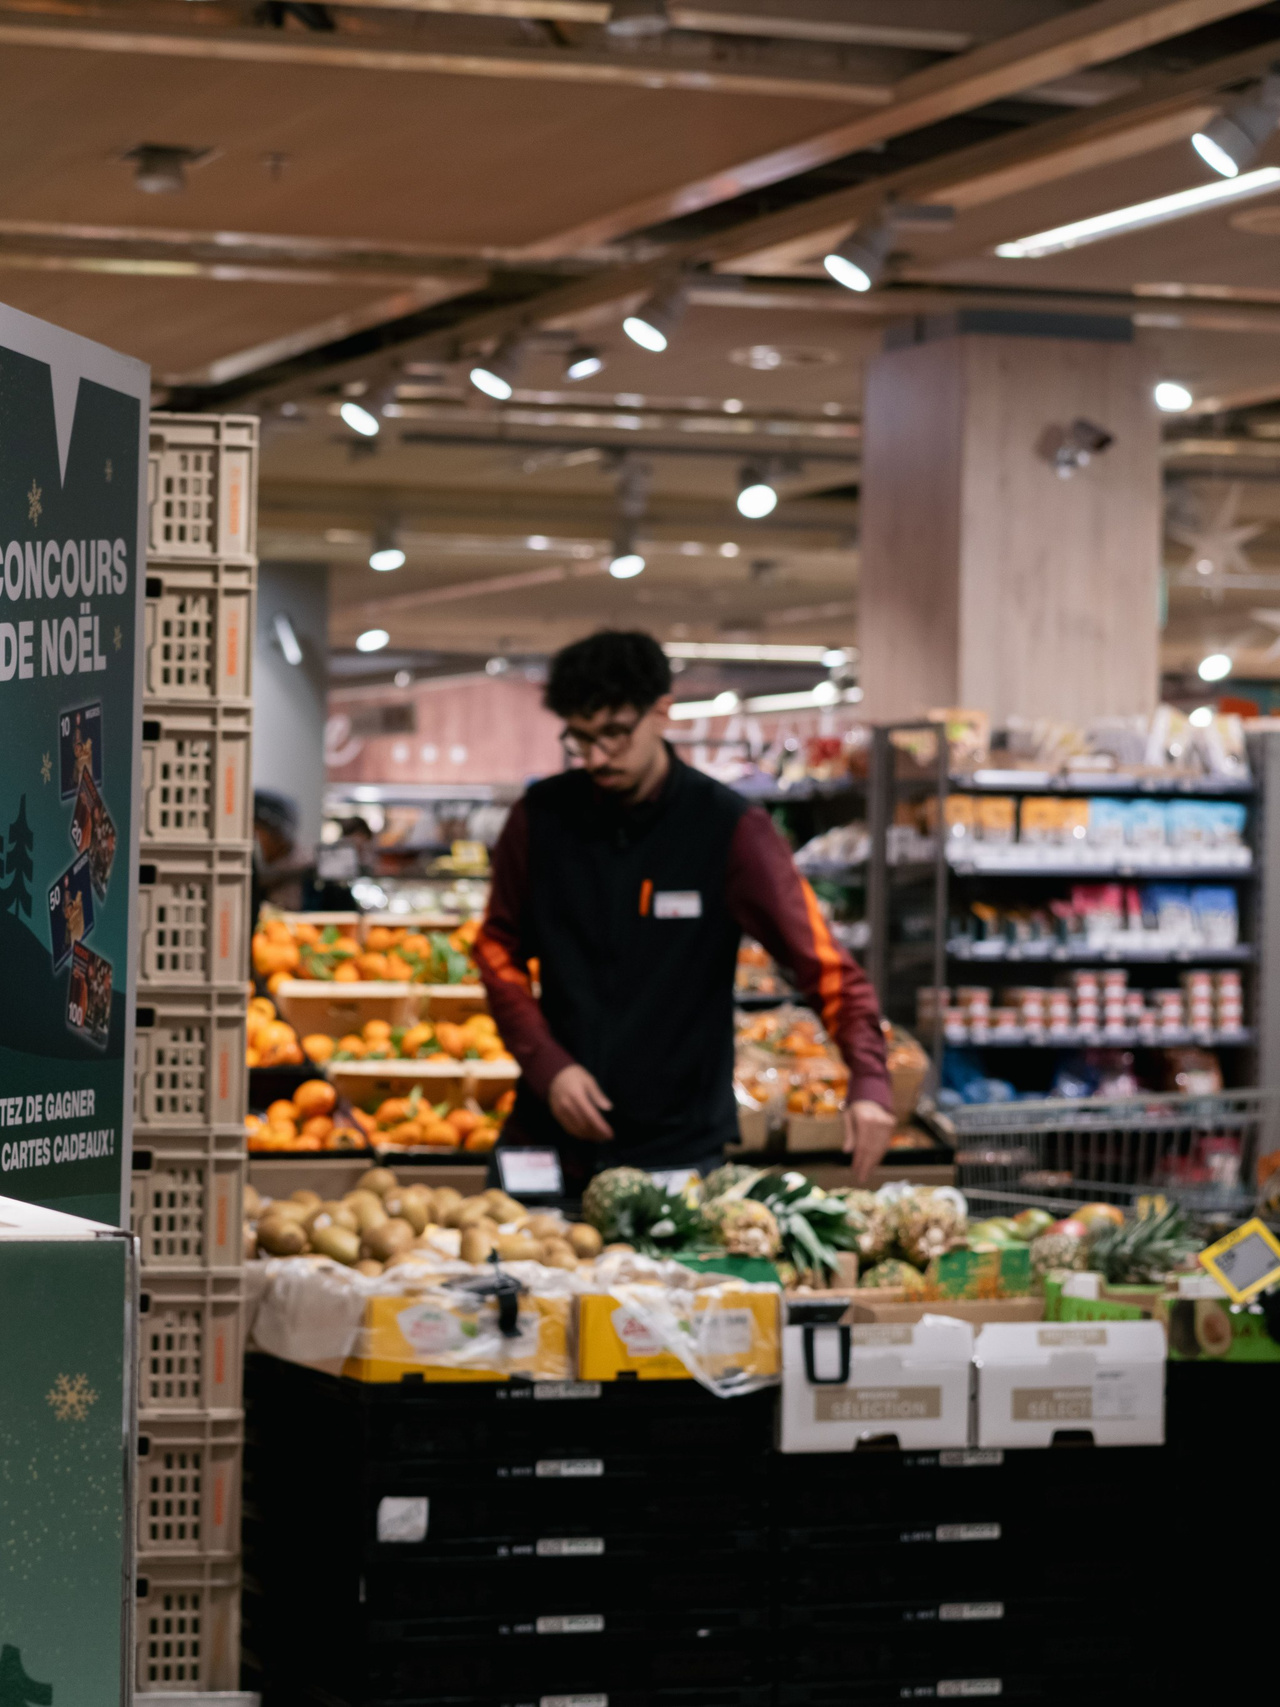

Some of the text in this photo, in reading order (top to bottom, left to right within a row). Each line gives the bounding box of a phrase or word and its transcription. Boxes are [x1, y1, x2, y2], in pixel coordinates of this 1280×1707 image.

[0, 602, 107, 682] DE NOËL
[61, 716, 70, 737] 10
[71, 819, 83, 847] 20
[50, 885, 61, 911] 50
[69, 1001, 83, 1026] 100
[25, 1094, 43, 1124] DE
[45, 1088, 95, 1122] GAGNER
[1, 1136, 51, 1172] CARTES
[830, 1398, 926, 1418] SÉLECTION
